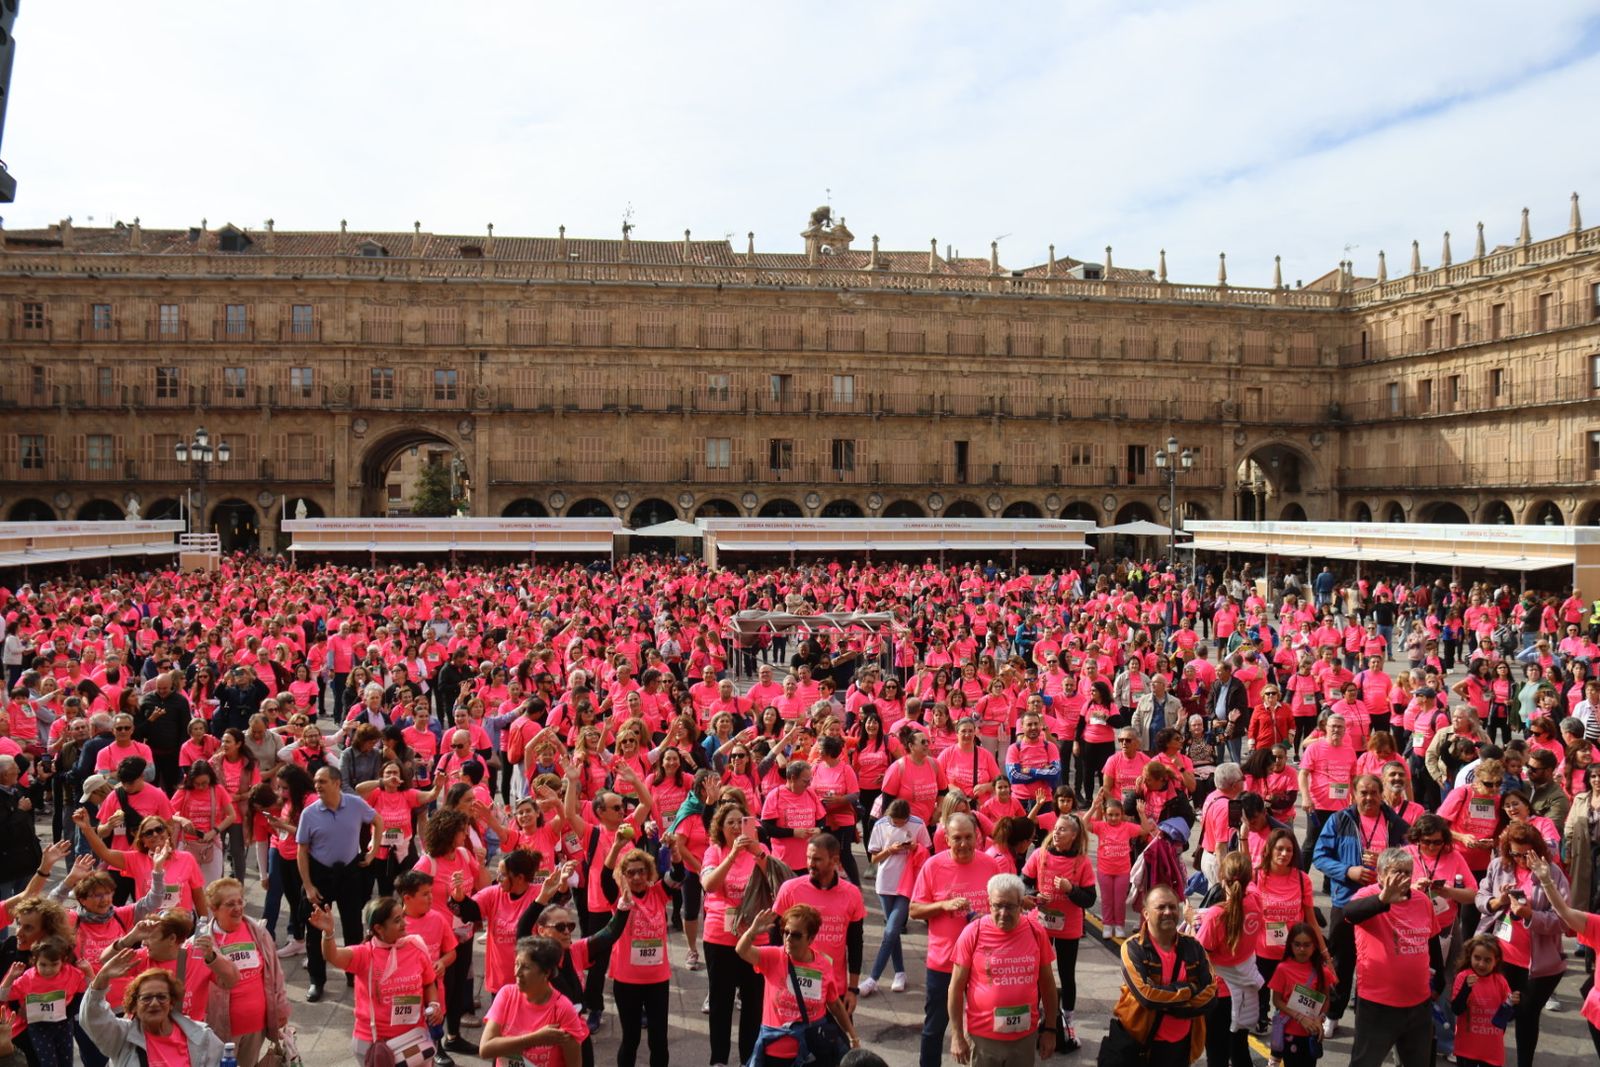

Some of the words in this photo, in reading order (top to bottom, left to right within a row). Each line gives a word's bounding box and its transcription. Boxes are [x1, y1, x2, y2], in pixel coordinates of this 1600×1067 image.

[639, 948, 656, 957] 1832
[991, 956, 1003, 965] En
[1004, 954, 1035, 964] marcha
[991, 964, 1026, 975] contra
[1027, 963, 1035, 972] el
[993, 974, 1034, 986] cáncer
[40, 1002, 54, 1012] 291
[1006, 1016, 1021, 1026] 521
